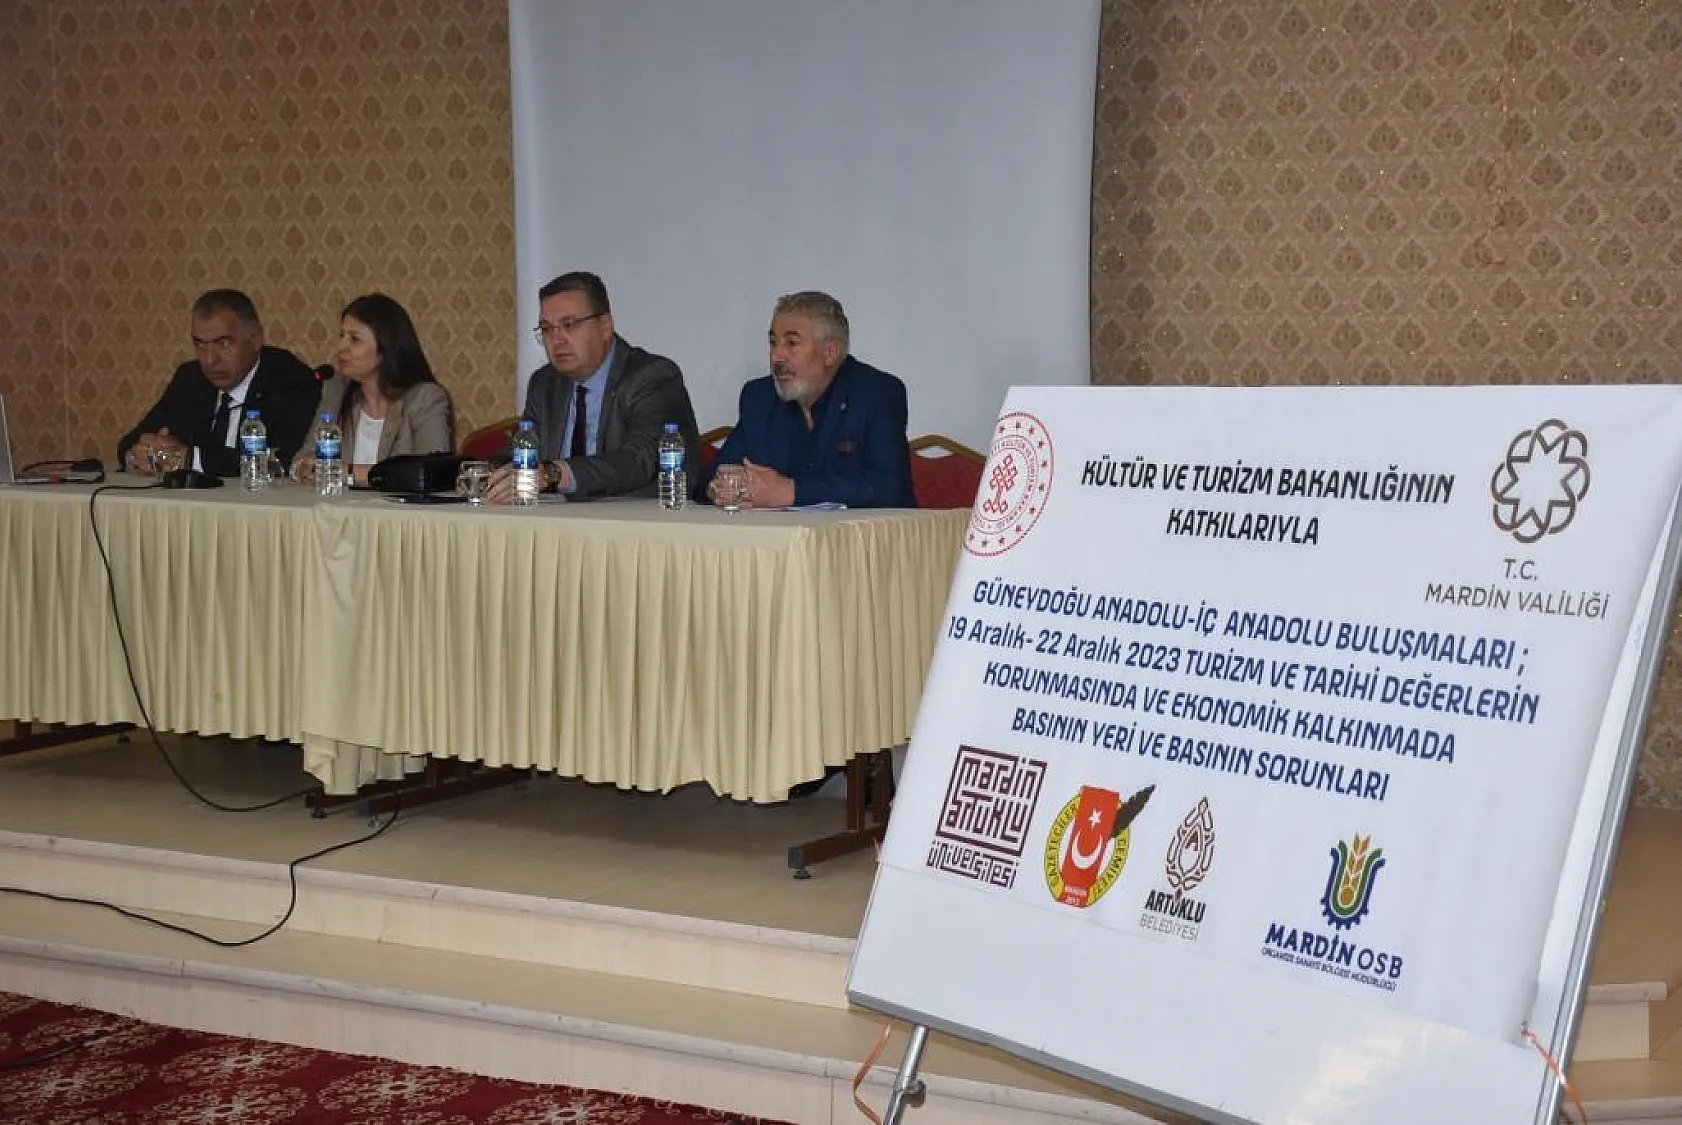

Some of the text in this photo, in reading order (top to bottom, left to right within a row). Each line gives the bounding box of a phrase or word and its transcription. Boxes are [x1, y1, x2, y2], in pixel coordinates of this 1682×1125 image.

[1081, 454, 1455, 504] KÜLTÜR VE TURİZM BAKANLIĞININ
[1166, 509, 1320, 546] KATKILARIYLA
[1503, 558, 1539, 581] T.C.
[973, 577, 1093, 618] GÜNEYDOĞU
[1092, 595, 1218, 638] ANADOLU-İÇ
[1224, 609, 1334, 648] ANADOLU
[1336, 622, 1516, 670] BULUŞMALARI
[1424, 583, 1610, 621] MARDİN VALİLİĞİ
[949, 615, 1541, 725] 19 Aralık- 22 Aralık 2023 TURİZM VE TARİHİ DEĞERLERİN
[983, 661, 1456, 764] KORUNMASINDA VE EKONOMİK KALKINMADA
[1011, 707, 1391, 801] BASININ YERİ VE BASININ SORUNLARI
[1145, 889, 1206, 923] ARTUKLU
[1264, 923, 1403, 978] MARDİN OSB
